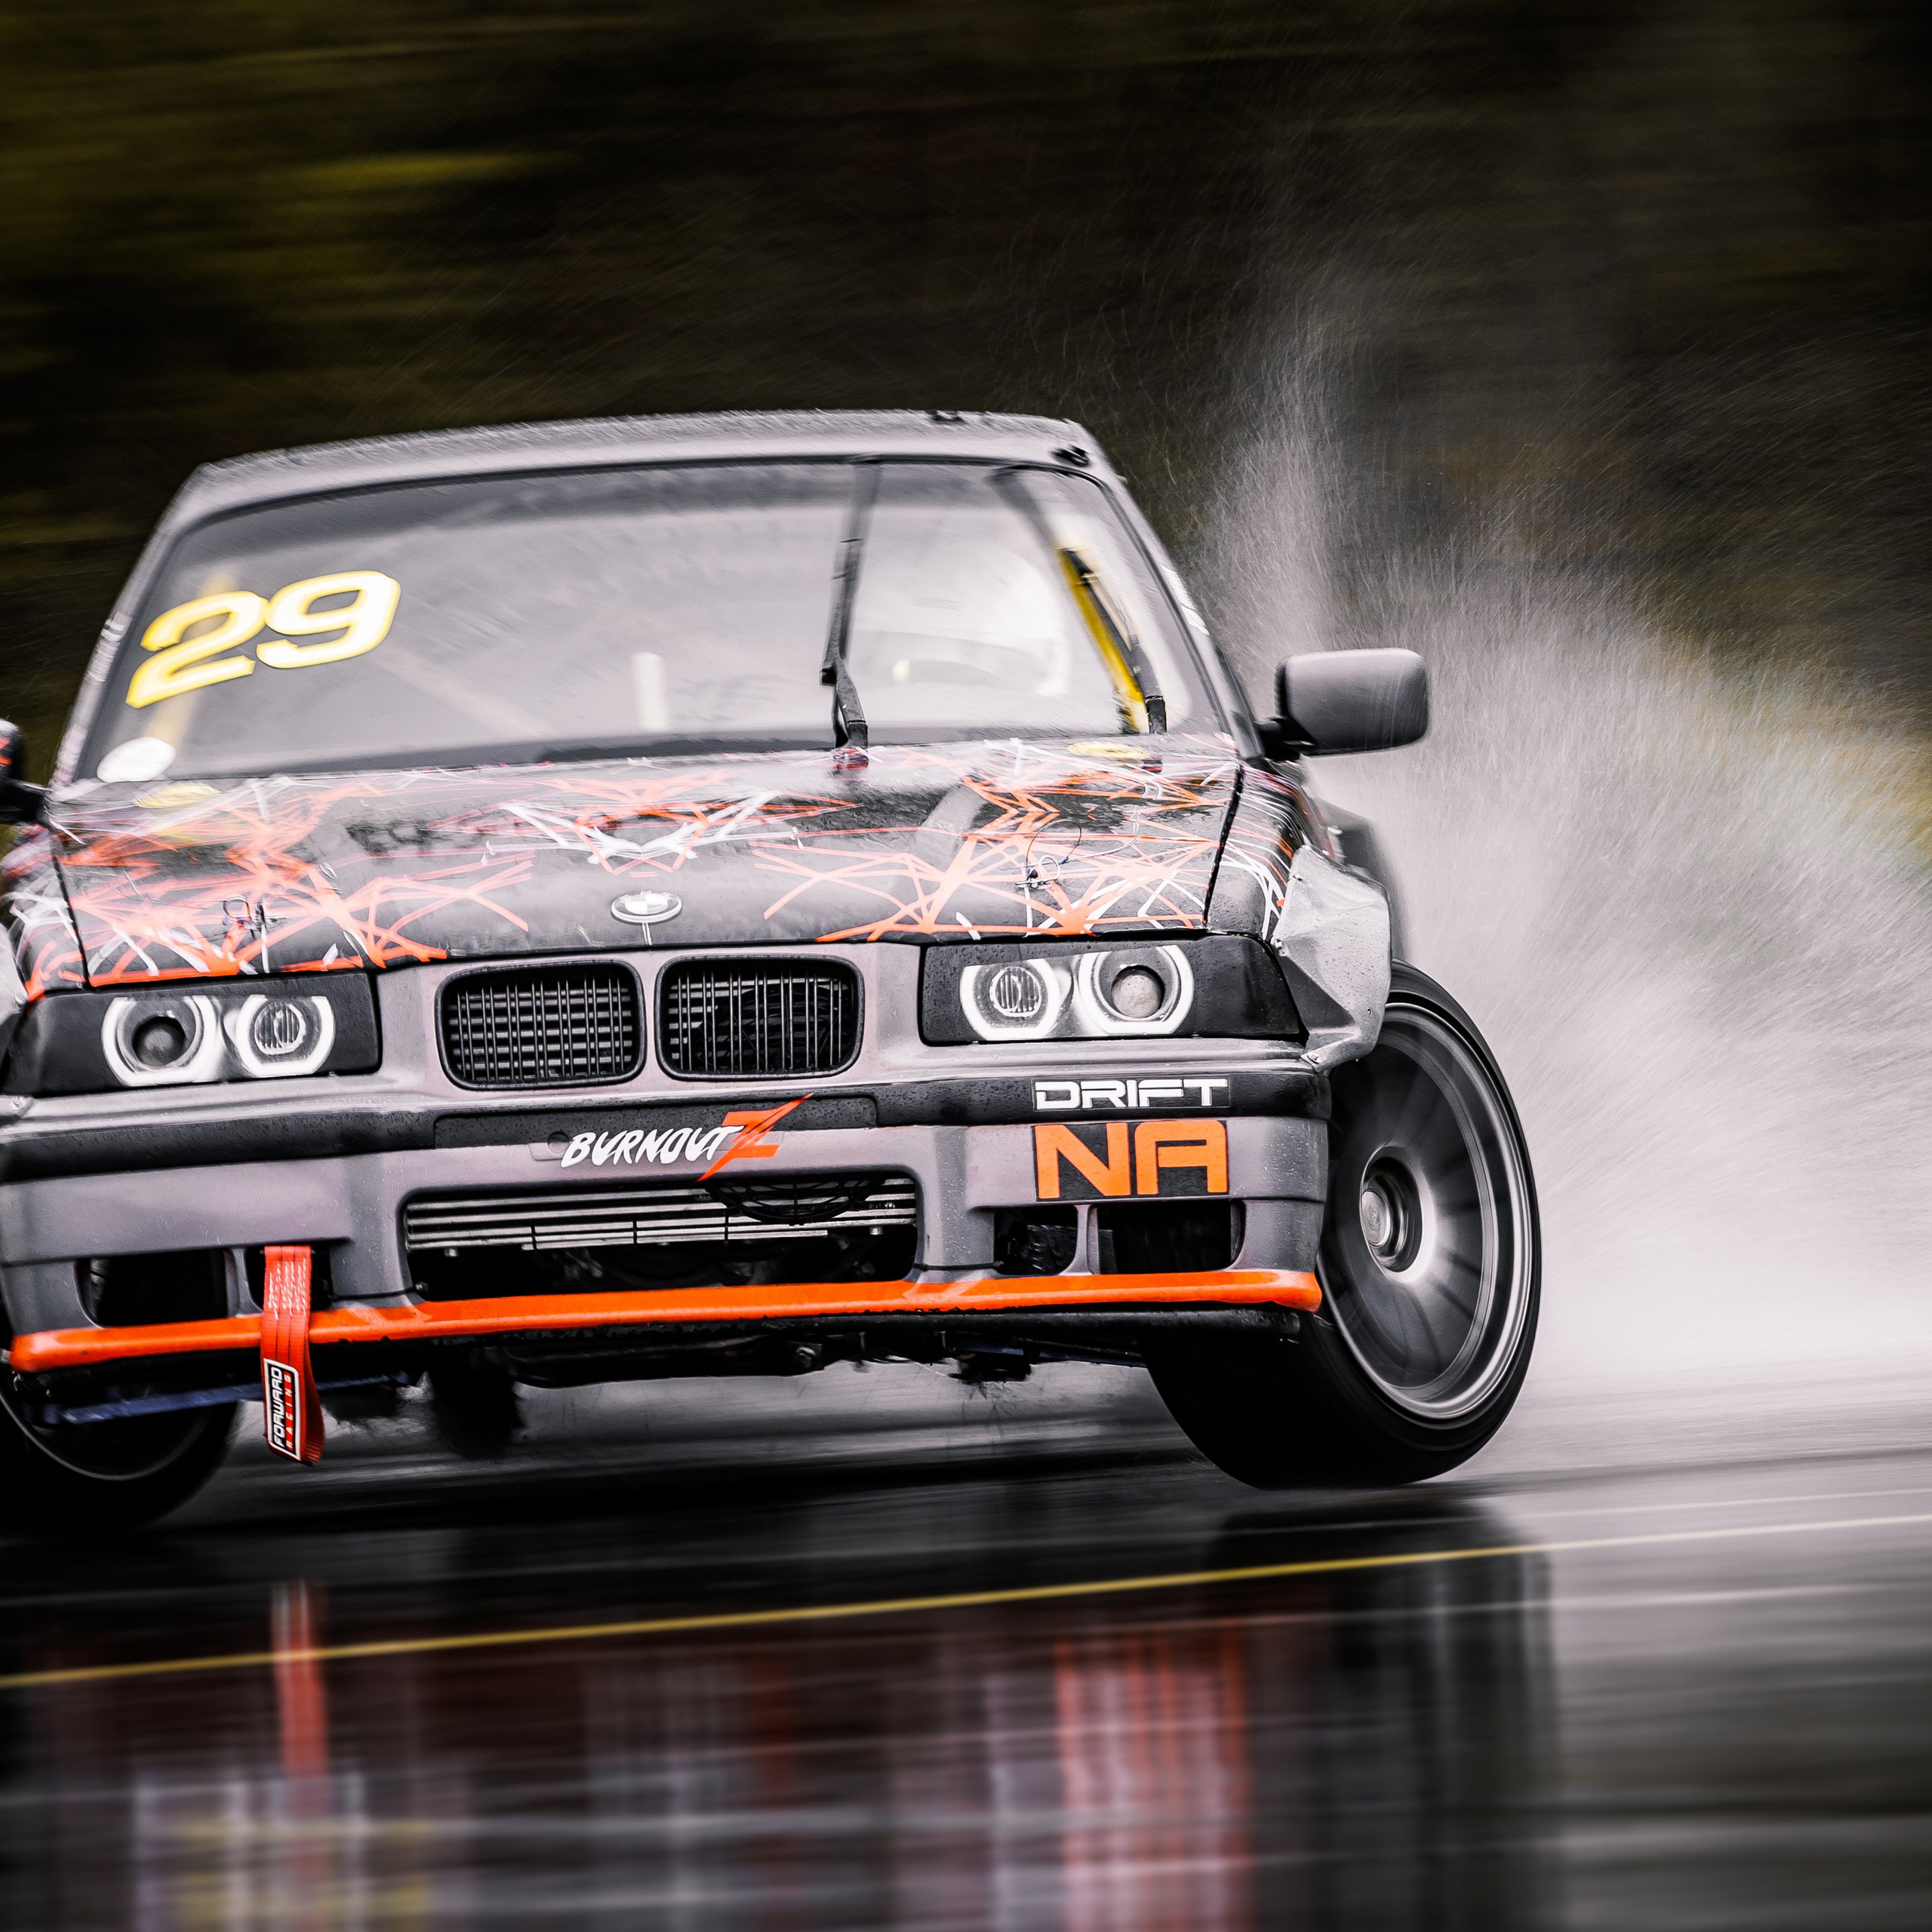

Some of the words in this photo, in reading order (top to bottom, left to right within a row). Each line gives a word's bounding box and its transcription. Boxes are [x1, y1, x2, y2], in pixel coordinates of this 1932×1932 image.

[126, 571, 401, 708] 29
[1035, 1078, 1228, 1109] DRIFT
[1035, 1120, 1228, 1198] NA
[271, 1367, 285, 1447] FORWARD
[285, 1374, 294, 1449] RACING
